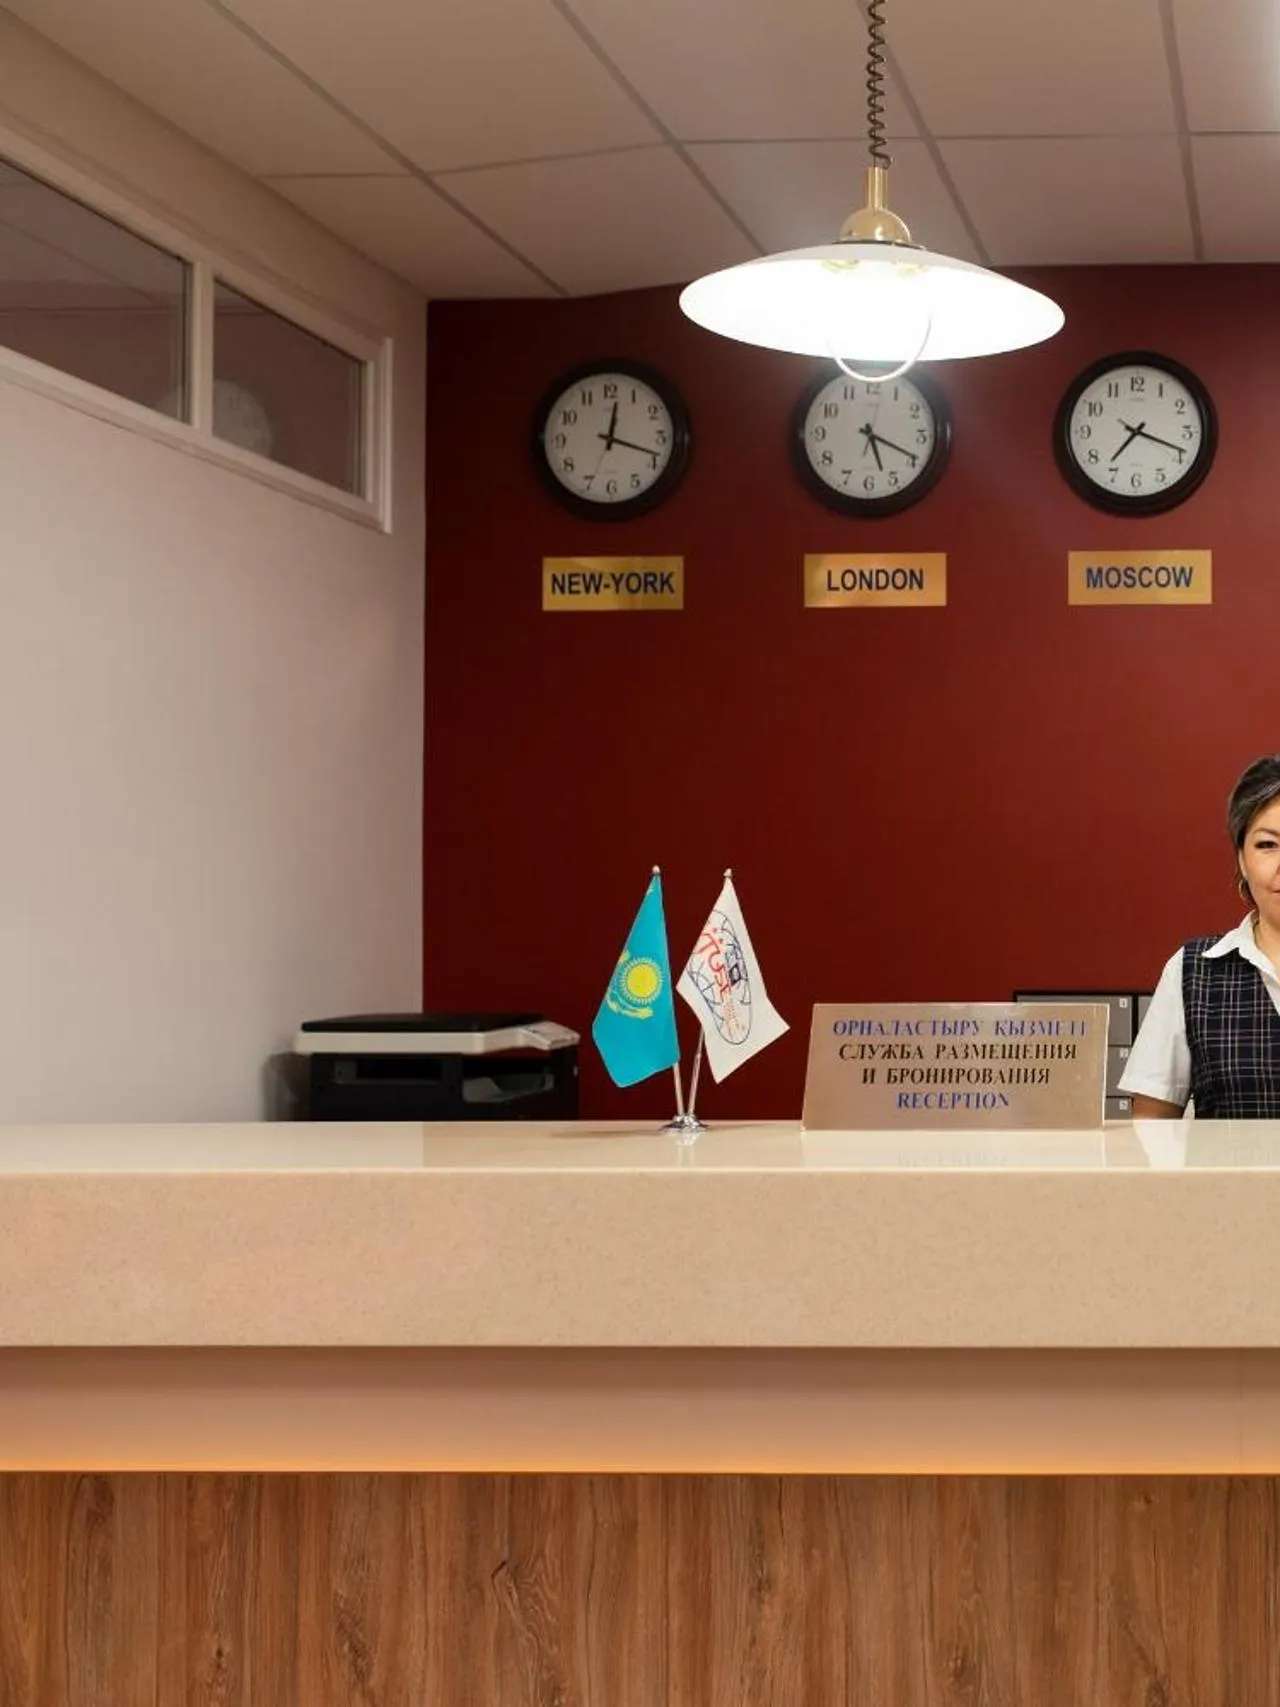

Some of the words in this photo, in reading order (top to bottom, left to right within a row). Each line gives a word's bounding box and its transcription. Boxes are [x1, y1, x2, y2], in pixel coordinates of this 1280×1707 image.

[604, 383, 617, 398] 12
[867, 383, 881, 394] 12
[1108, 383, 1118, 397] 11
[1130, 377, 1145, 392] 12
[1159, 383, 1163, 397] 1
[582, 391, 592, 406] 11
[632, 389, 636, 404] 1
[844, 386, 854, 400] 11
[894, 387, 898, 401] 1
[648, 405, 659, 420] 2
[824, 403, 838, 418] 10
[910, 404, 919, 419] 2
[1088, 402, 1103, 416] 10
[1175, 399, 1185, 414] 2
[563, 410, 577, 425] 10
[656, 430, 666, 445] 3
[815, 426, 826, 441] 9
[916, 429, 926, 444] 3
[1080, 425, 1091, 439] 9
[1182, 425, 1193, 440] 3
[555, 433, 566, 448] 9
[563, 457, 574, 472] 8
[822, 451, 833, 465] 8
[1088, 450, 1098, 464] 8
[584, 475, 595, 490] 7
[630, 474, 640, 487] 5
[842, 470, 852, 485] 7
[888, 471, 898, 486] 5
[1108, 468, 1119, 483] 7
[1131, 473, 1142, 488] 6
[1155, 468, 1165, 482] 5
[606, 479, 617, 494] 6
[863, 476, 874, 490] 6
[551, 571, 675, 595] NEW-YORK
[826, 568, 924, 591] LONDON
[1086, 566, 1194, 588] MOSCOW
[839, 1044, 924, 1060] СЛУЖБА
[935, 1044, 1077, 1061] РАЗМЕЩЕНИЯ
[862, 1068, 876, 1084] И
[887, 1068, 1051, 1085] БРОНИРОВАНИЯ
[897, 1092, 1010, 1109] RECEPTION
